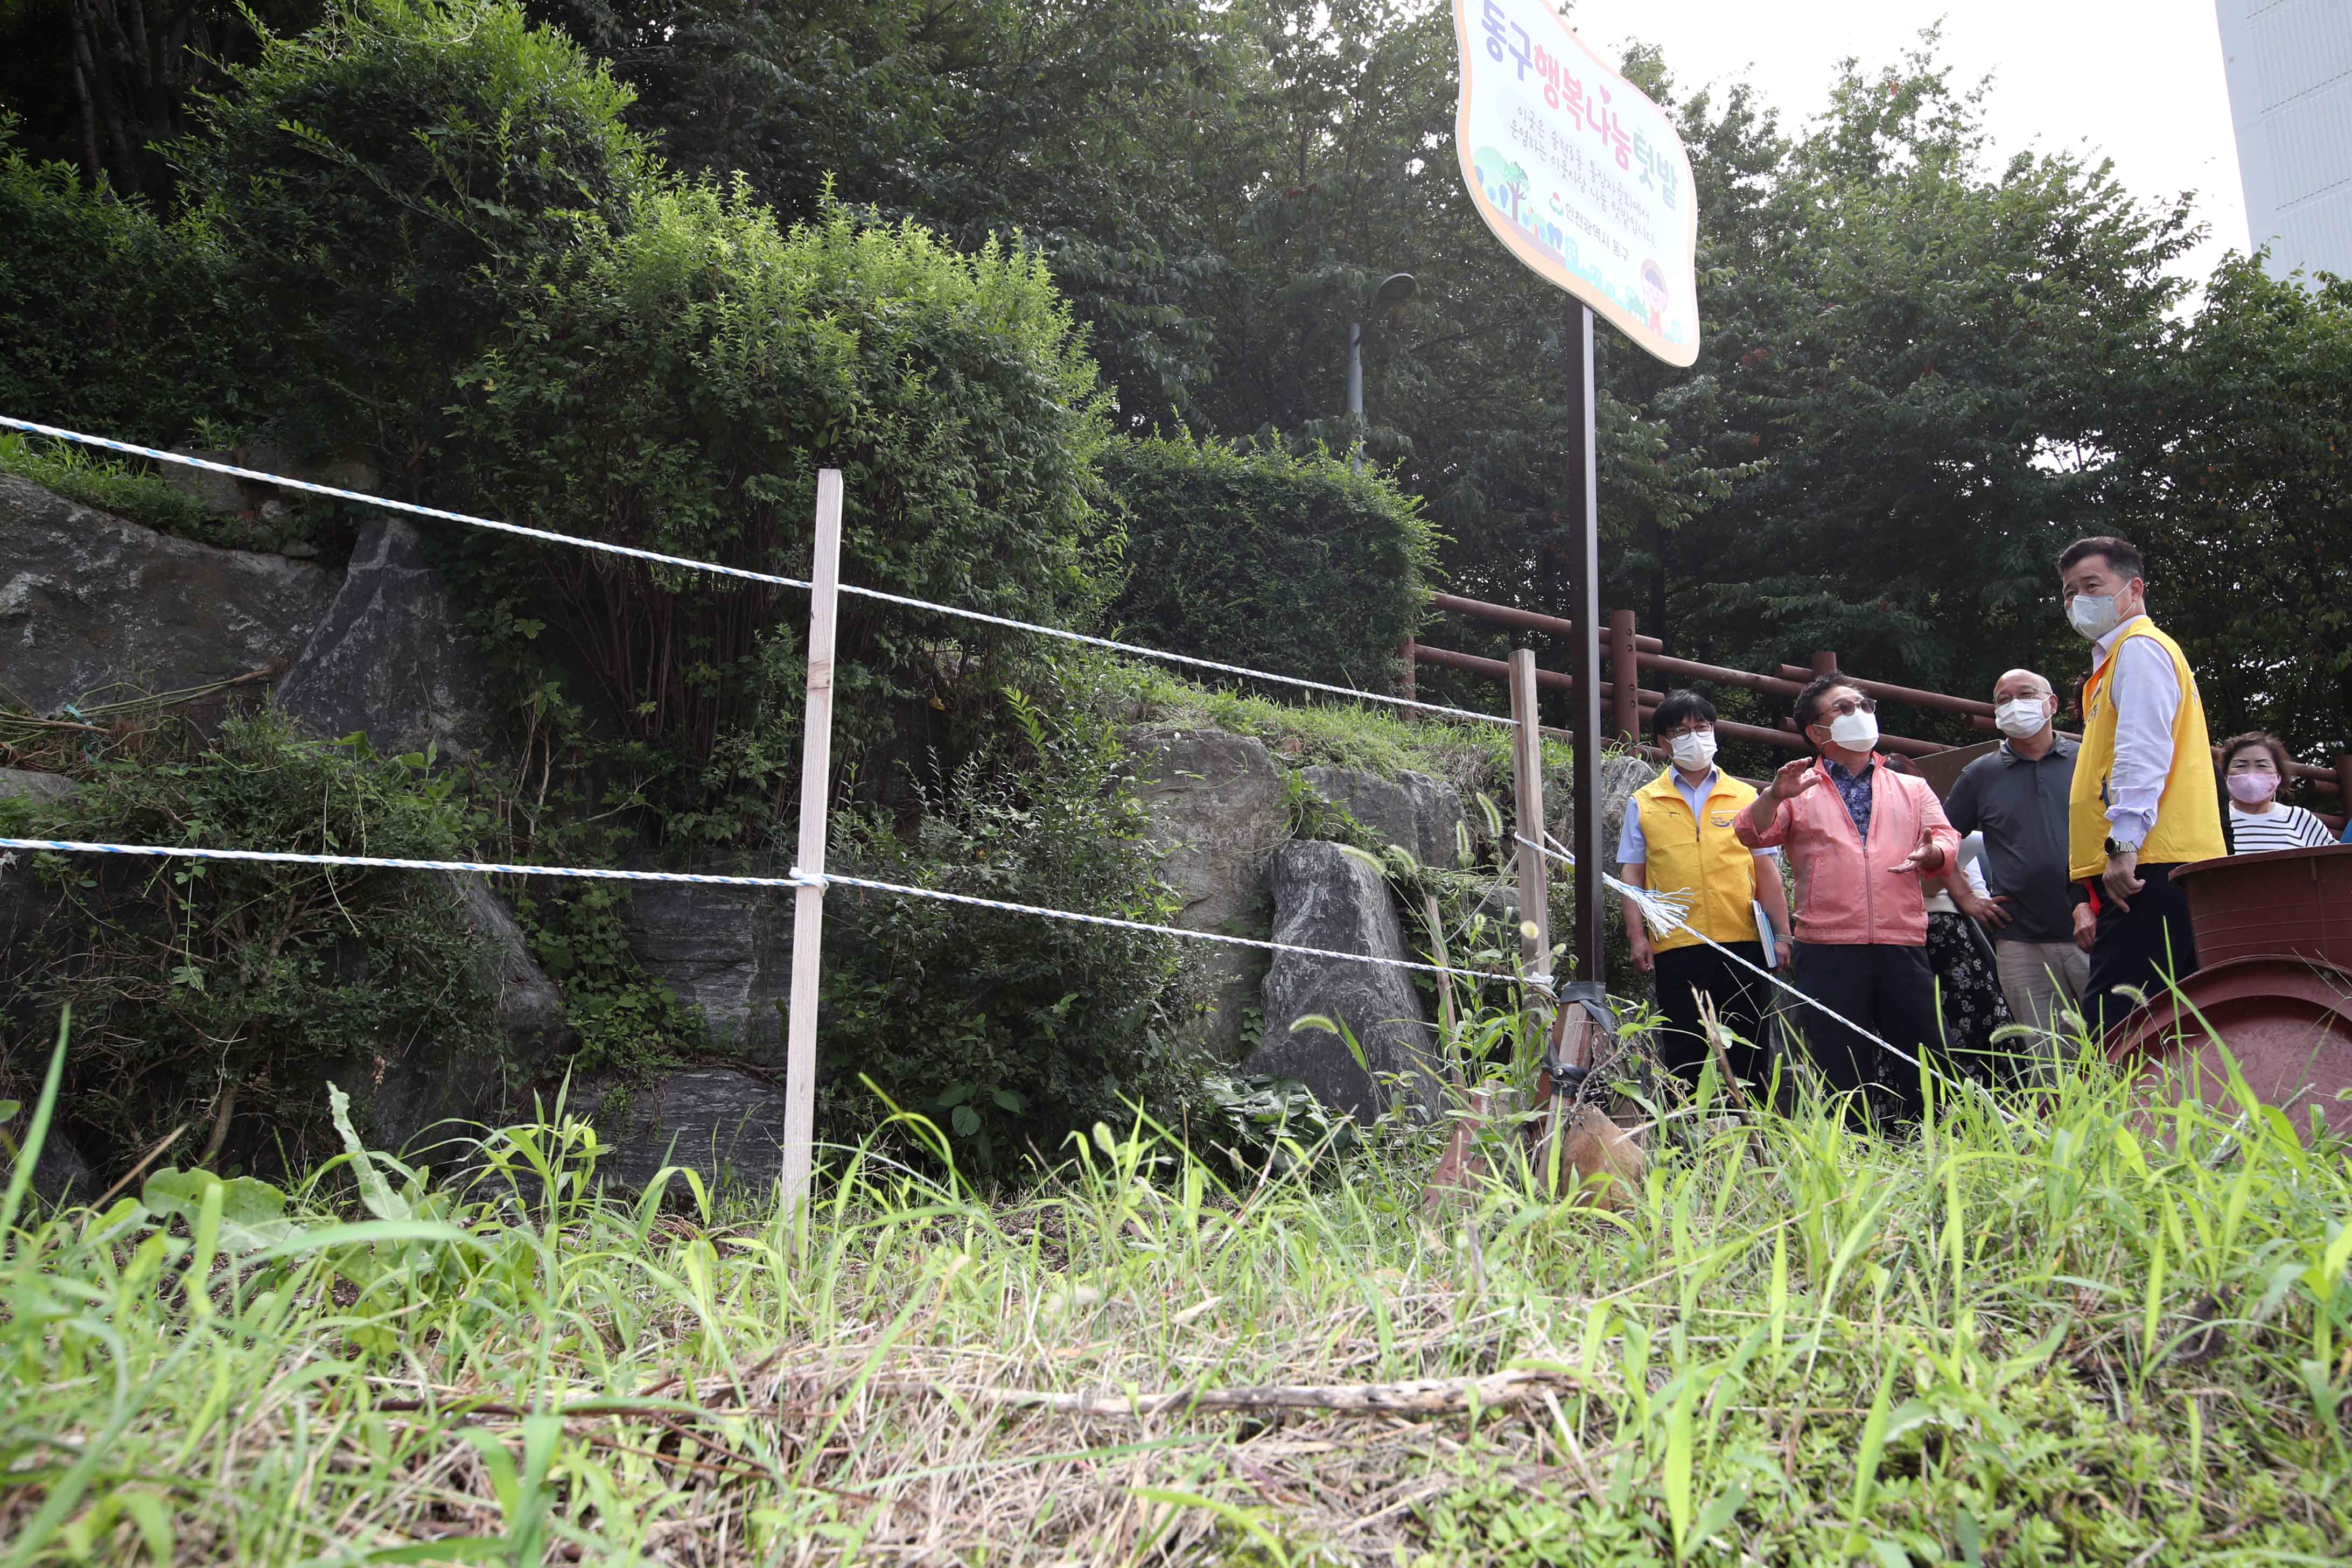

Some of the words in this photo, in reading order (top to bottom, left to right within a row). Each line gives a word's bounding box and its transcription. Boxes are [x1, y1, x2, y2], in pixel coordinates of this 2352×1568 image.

[1518, 107, 1545, 139] 이곳은
[1510, 120, 1547, 162] 운영하는
[1551, 156, 1586, 193] 이웃사랑
[1590, 186, 1607, 211] 나눔
[1566, 203, 1609, 250] 인천광역시
[1613, 239, 1628, 263] 동구
